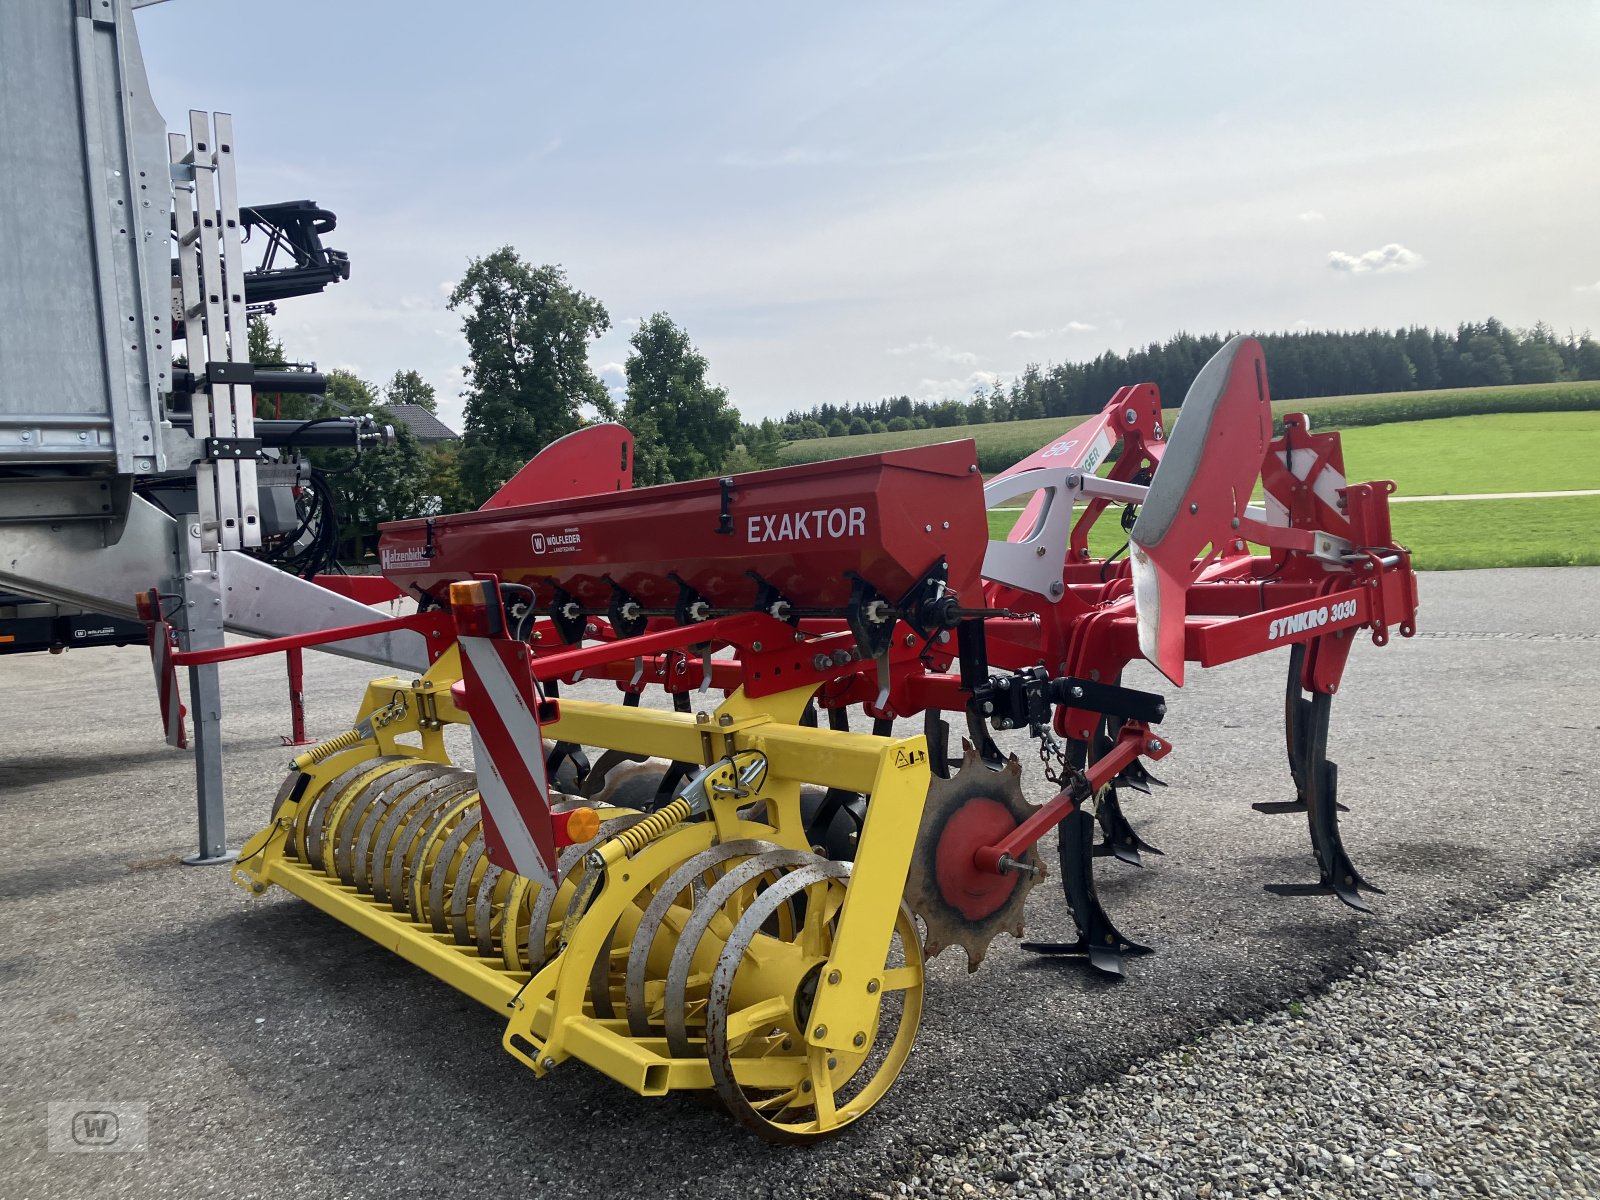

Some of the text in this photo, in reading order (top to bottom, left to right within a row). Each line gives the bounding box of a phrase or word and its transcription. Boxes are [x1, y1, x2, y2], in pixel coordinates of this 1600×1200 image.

[747, 506, 866, 543] EXAKTOR
[1268, 599, 1357, 640] SYNKRO 3030
